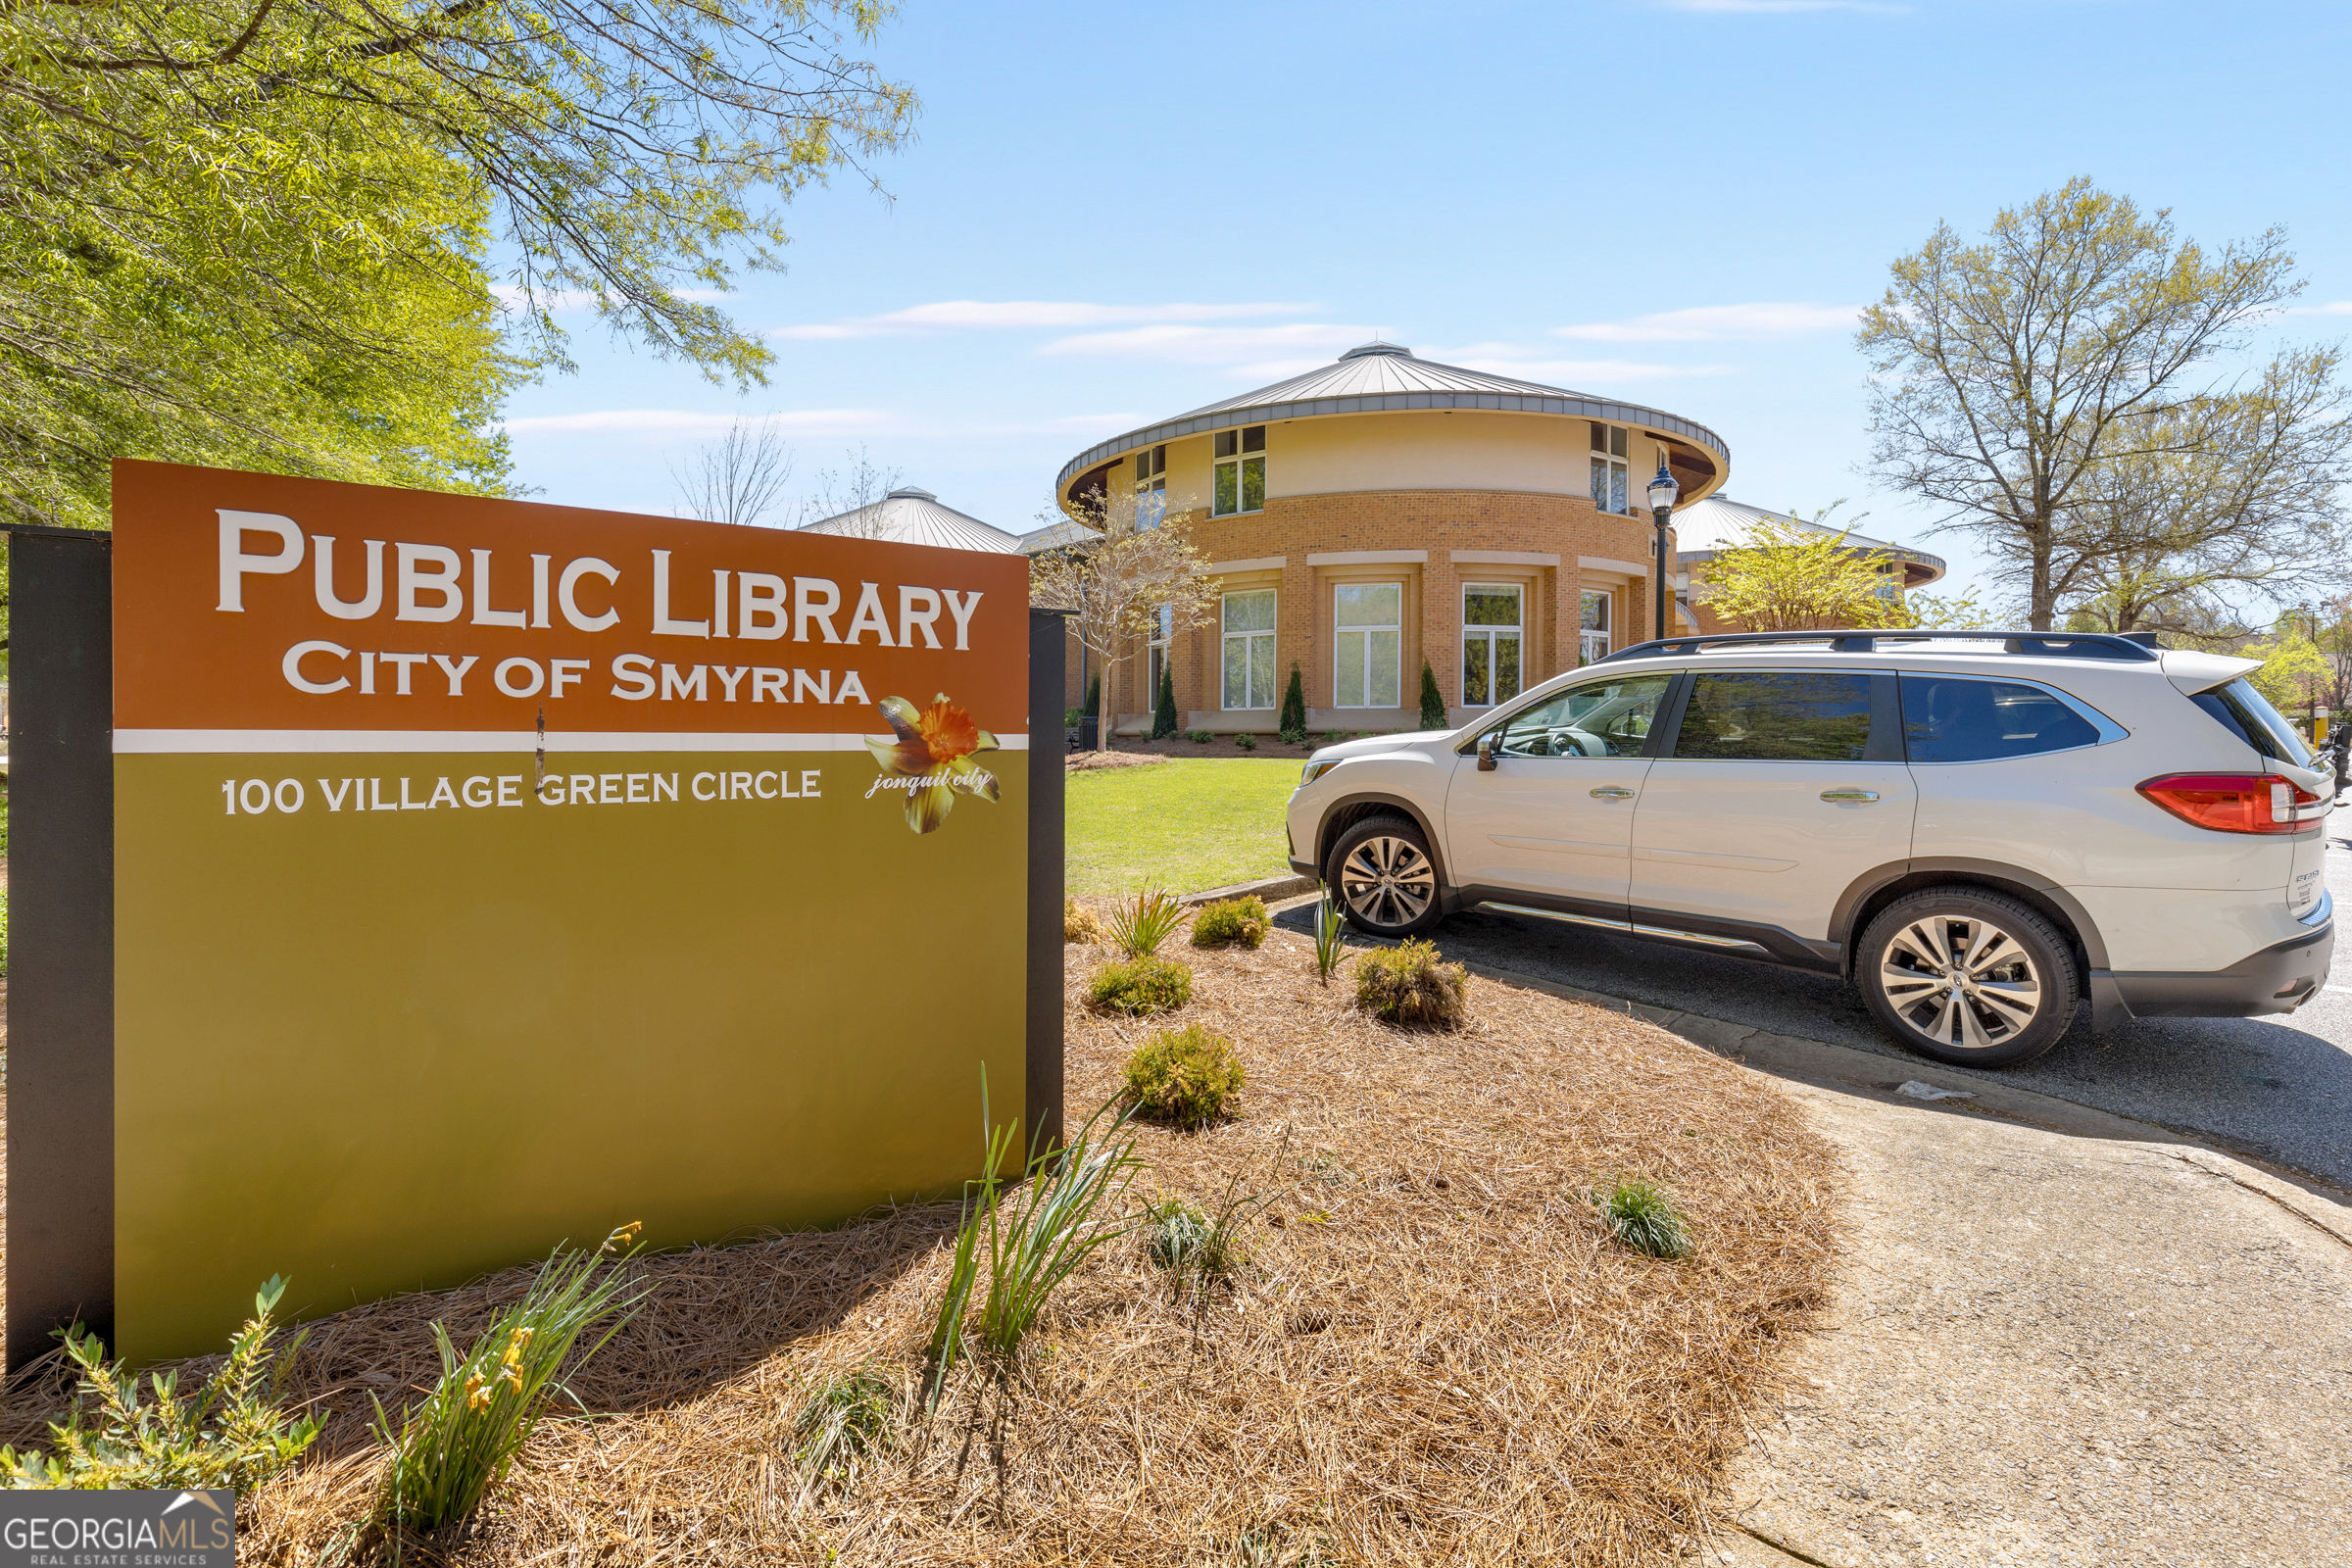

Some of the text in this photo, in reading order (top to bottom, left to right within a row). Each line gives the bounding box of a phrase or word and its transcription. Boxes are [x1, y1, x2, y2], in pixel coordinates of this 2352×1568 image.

[215, 509, 985, 652] PUBLIC LIBRARY
[281, 640, 872, 706] CITY OF SMYRNA
[221, 769, 821, 815] 100 VILLAGE GREEN CIRCLE
[864, 766, 994, 799] jonquil city
[1869, 906, 1914, 944] IDGESTONE
